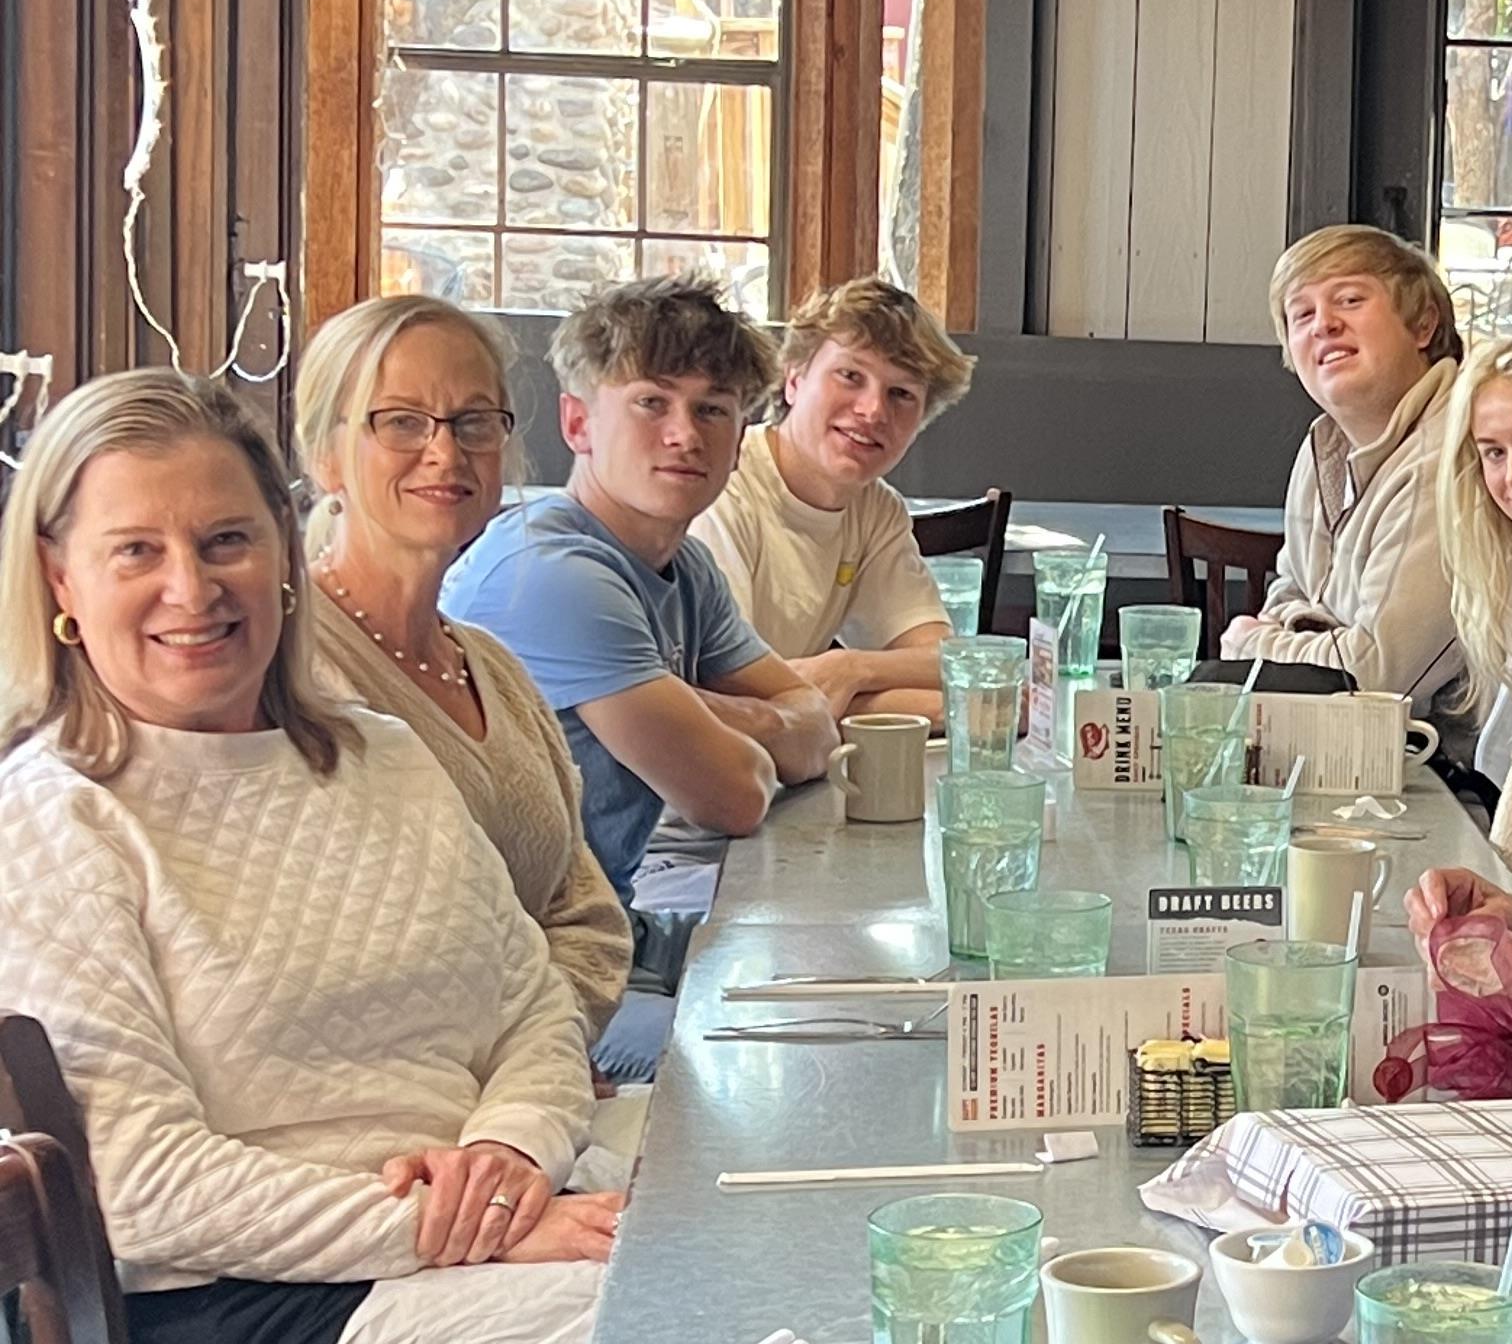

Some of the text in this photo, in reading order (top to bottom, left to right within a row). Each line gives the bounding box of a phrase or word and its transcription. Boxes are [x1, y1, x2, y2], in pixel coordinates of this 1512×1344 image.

[1114, 696, 1133, 784] DRINK MENU
[1158, 893, 1275, 913] DRAFT BEERS
[1181, 987, 1191, 1036] PECIALS
[989, 1006, 999, 1120] PREMIUM TEQUILAS
[1036, 1043, 1046, 1118] MARGARITAS
